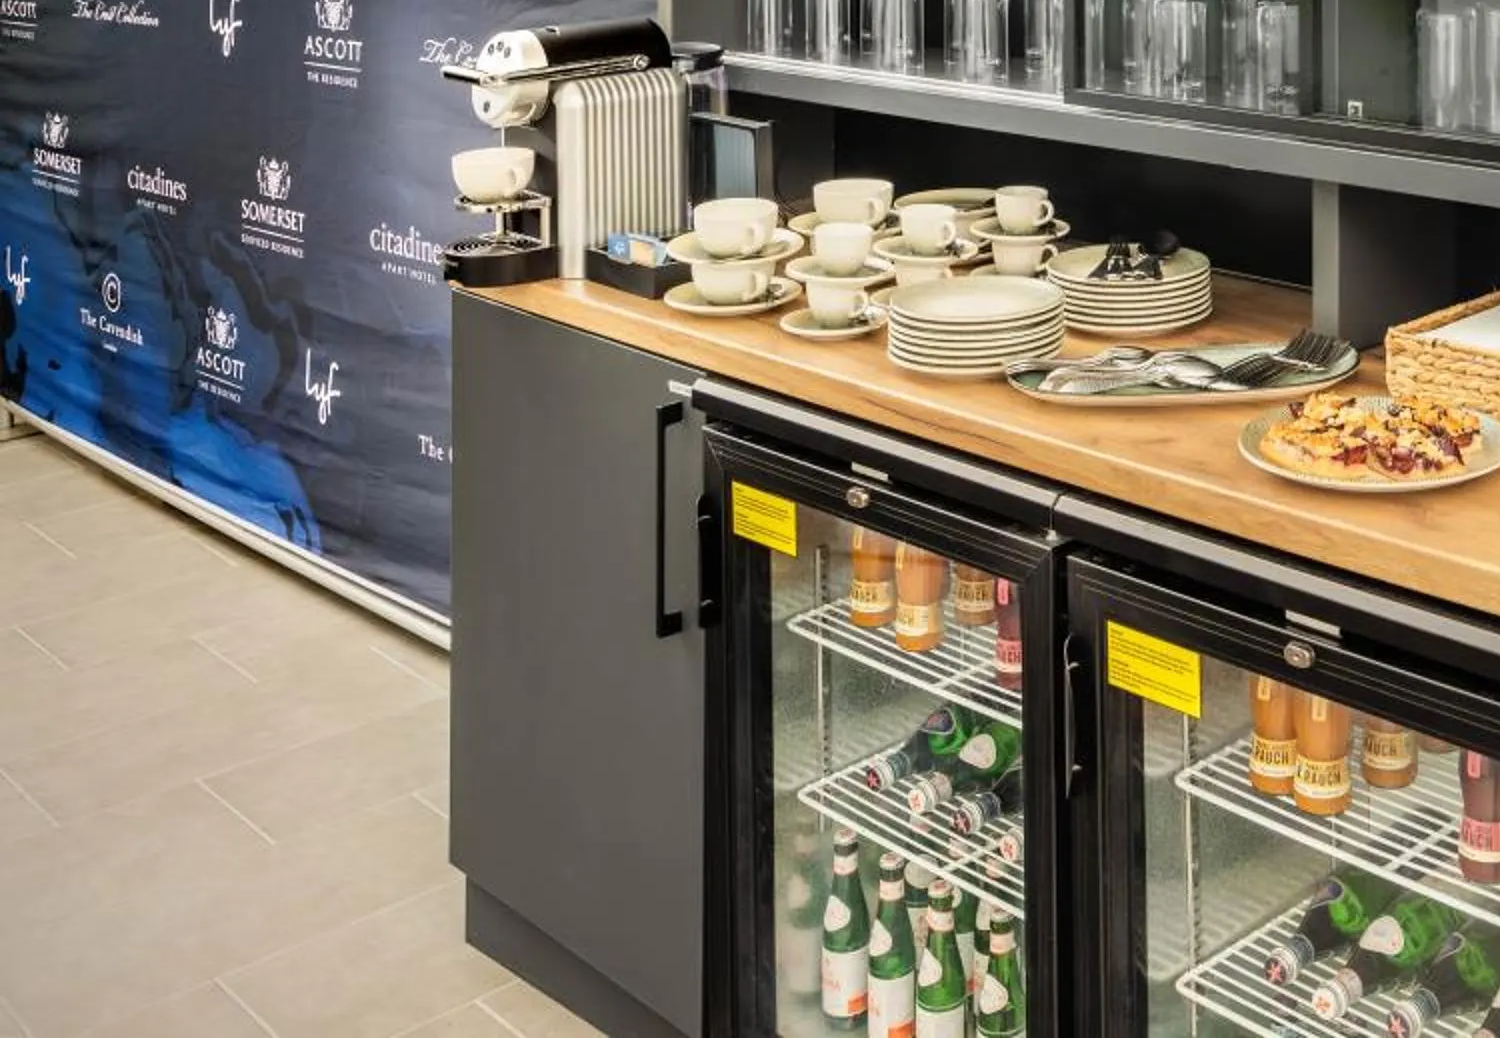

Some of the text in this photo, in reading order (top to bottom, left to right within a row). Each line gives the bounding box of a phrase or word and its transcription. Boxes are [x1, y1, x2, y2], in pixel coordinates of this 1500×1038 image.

[304, 35, 363, 62] ASCOTT
[33, 147, 82, 175] SOMERSET
[127, 165, 188, 201] citadines
[241, 199, 305, 232] SOMERSET
[369, 222, 441, 266] citadine
[80, 307, 144, 346] The Cavendish
[195, 347, 246, 380] ASCOTT
[305, 347, 341, 425] lyf
[418, 434, 444, 461] The
